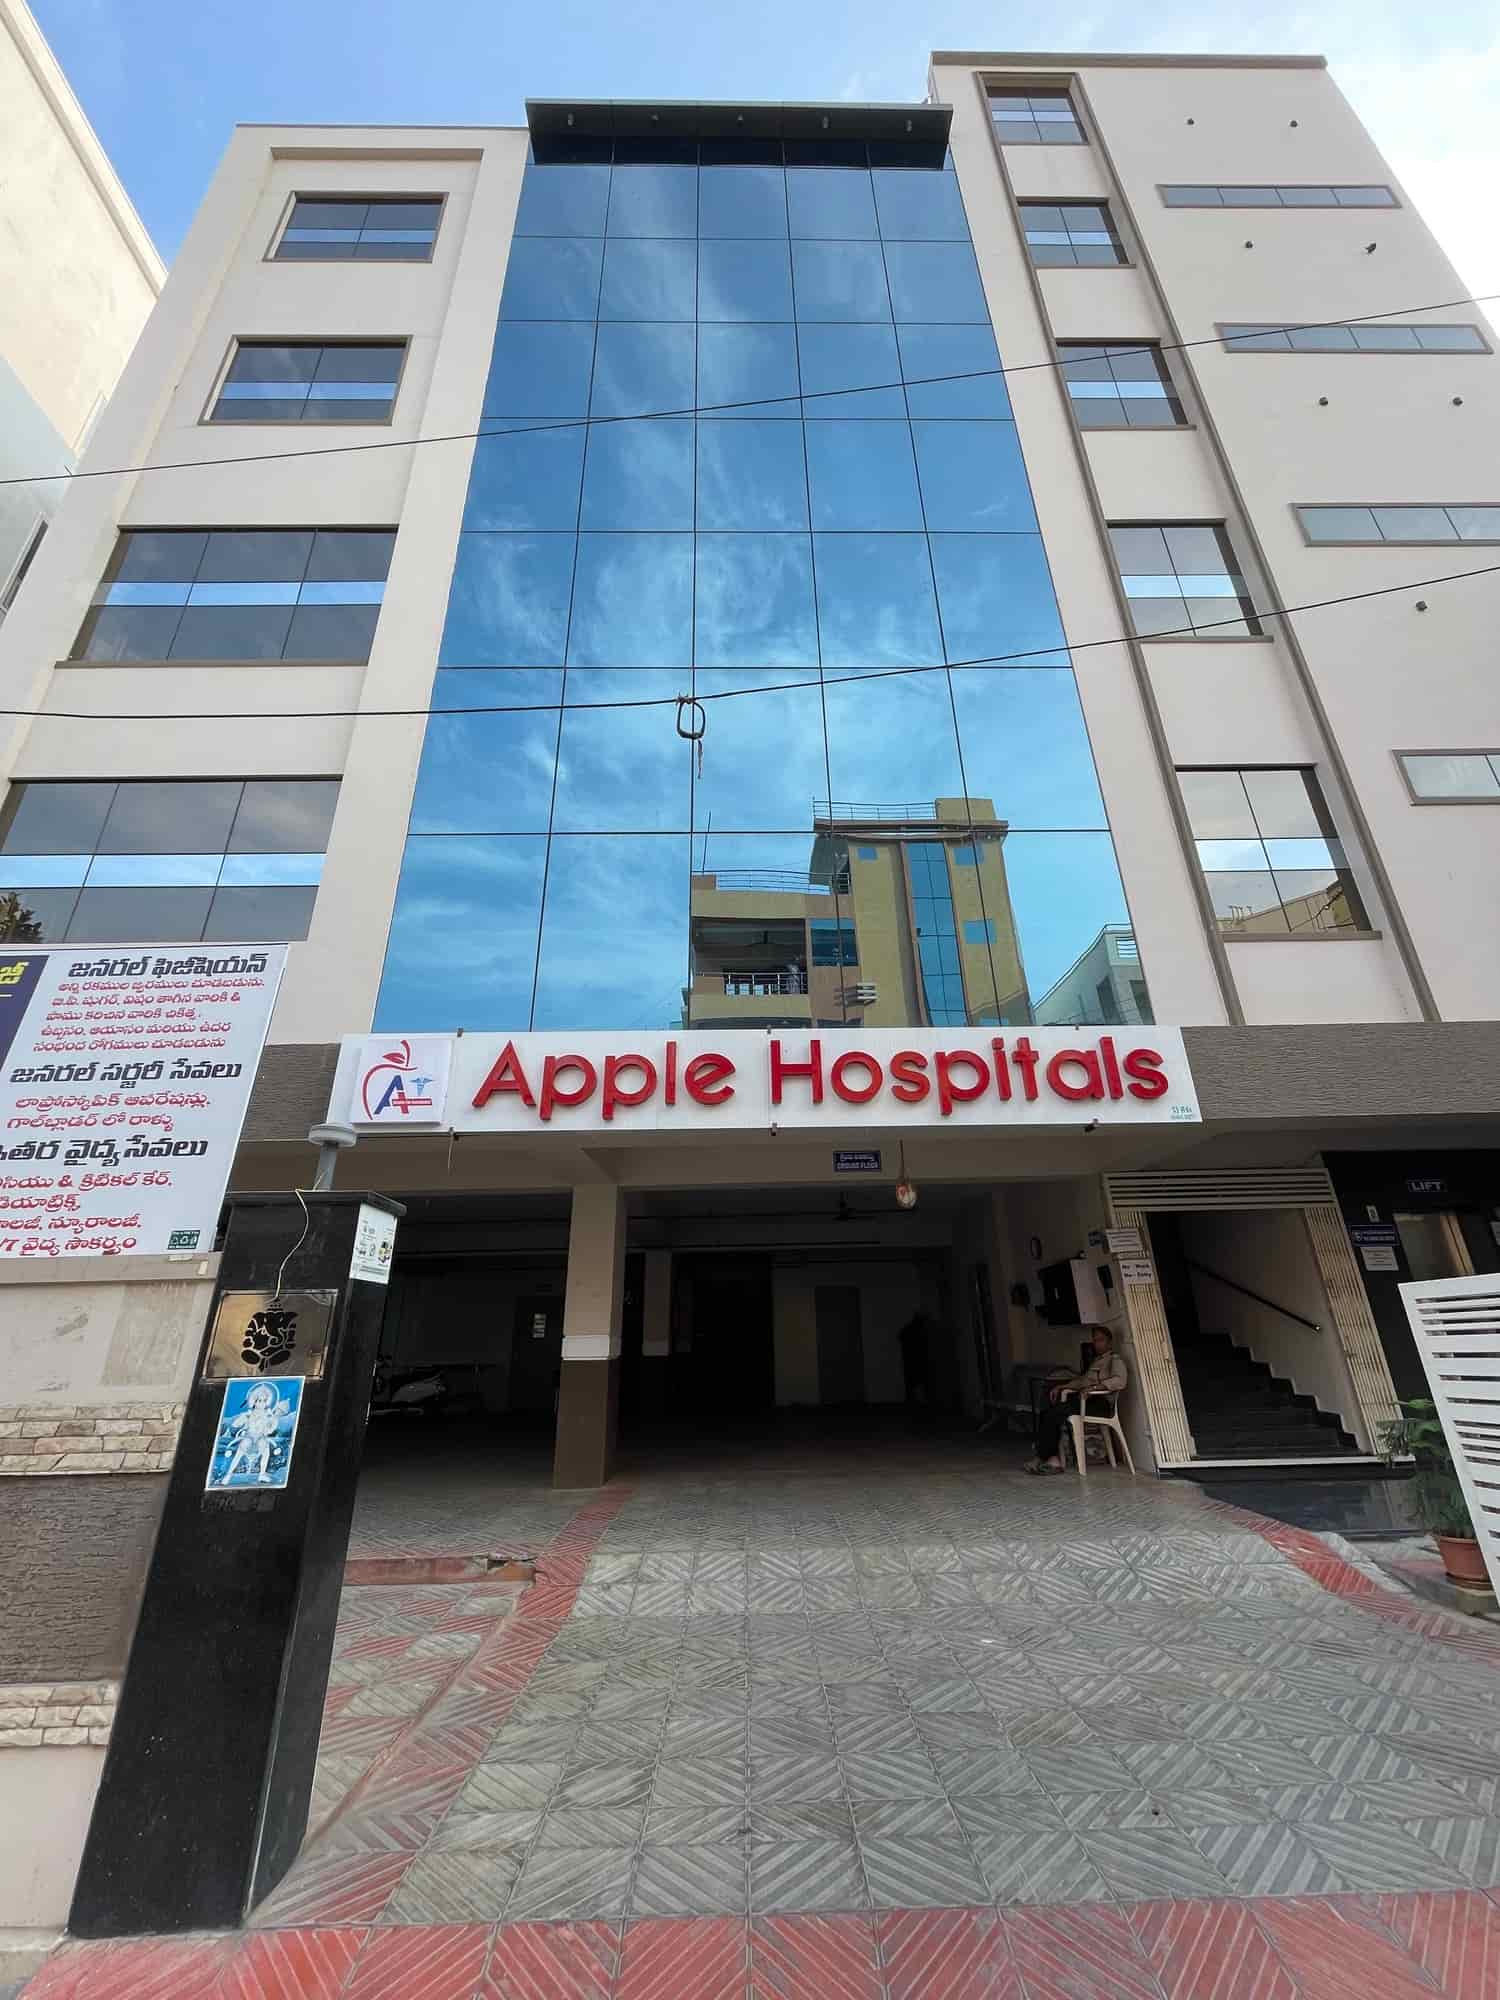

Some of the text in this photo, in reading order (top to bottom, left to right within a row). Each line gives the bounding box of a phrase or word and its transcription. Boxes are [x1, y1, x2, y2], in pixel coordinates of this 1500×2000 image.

[69, 953, 269, 979] జనరల్ ఫిజీషియన్
[10, 1058, 242, 1089] జనరల్ సర్జరీ సేవలు
[474, 1035, 1169, 1121] Apple Hospitals
[102, 1112, 126, 1126] లో
[64, 1139, 120, 1167] వైద్య
[123, 1135, 208, 1158] సేవలు
[58, 1175, 72, 1188] &
[1411, 1181, 1441, 1191] LIFT
[21, 1238, 60, 1256] వైద్య
